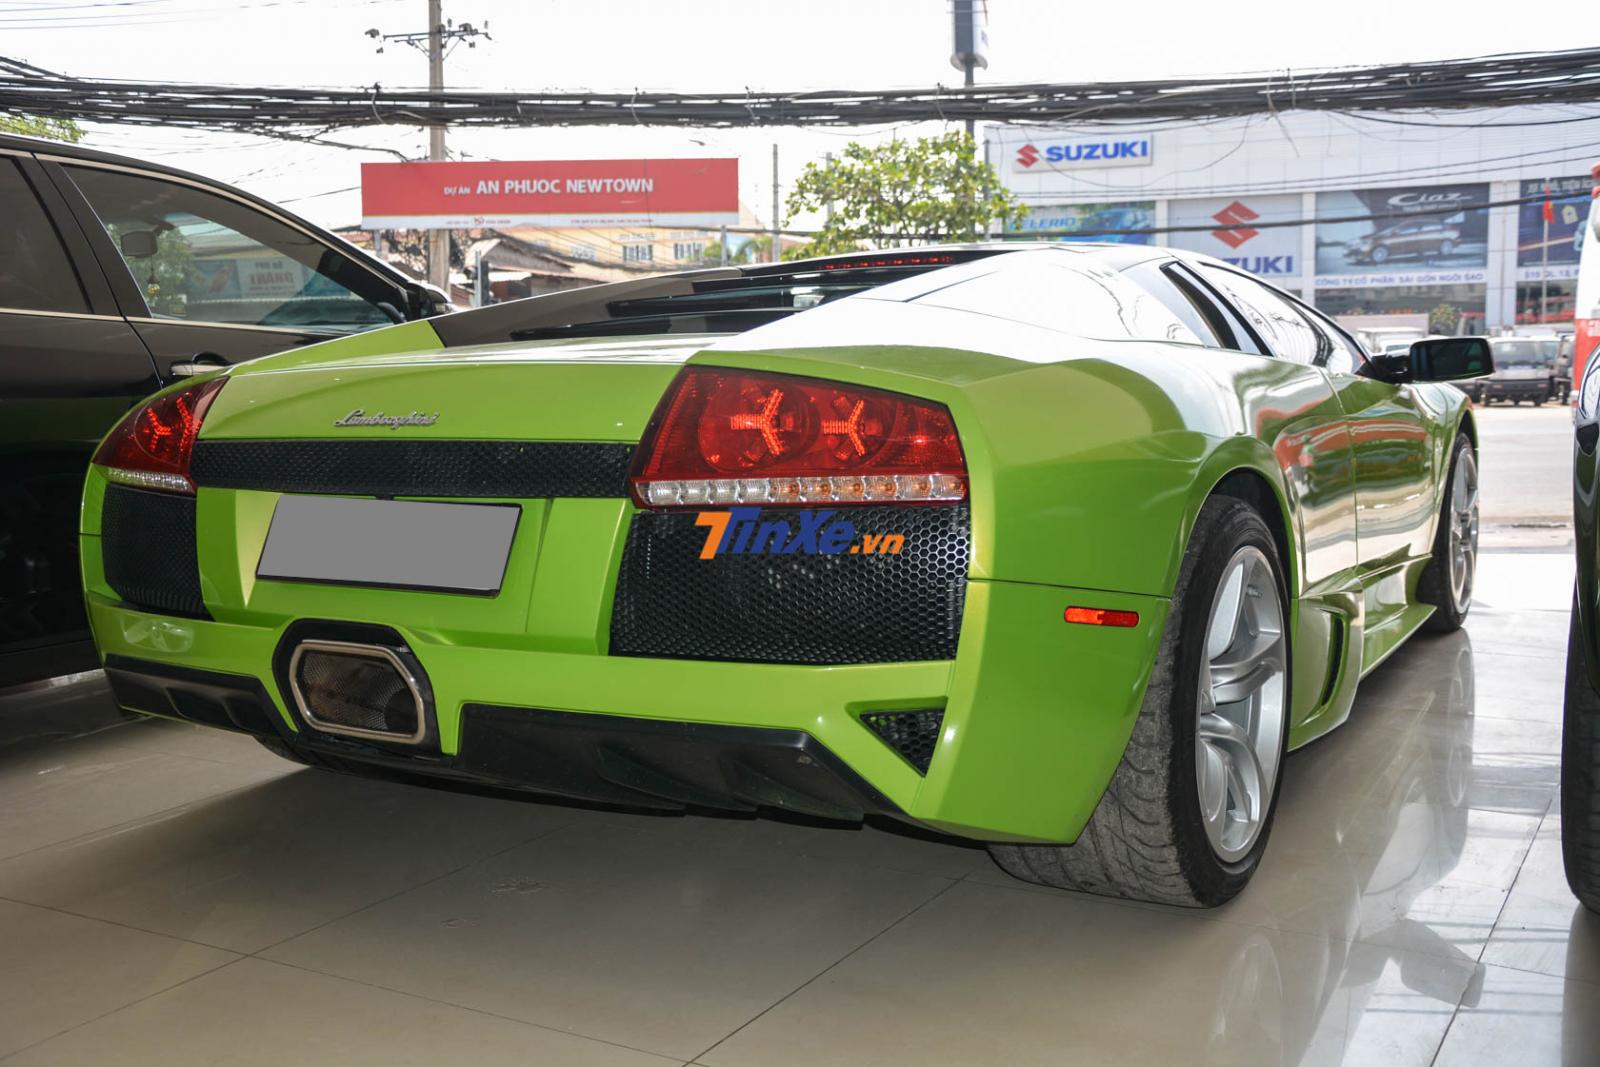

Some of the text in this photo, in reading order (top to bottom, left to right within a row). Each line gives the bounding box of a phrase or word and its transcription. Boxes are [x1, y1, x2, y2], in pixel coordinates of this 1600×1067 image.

[1046, 141, 1148, 162] SUZUKI
[476, 180, 500, 194] AN
[504, 179, 561, 193] PHUOC
[566, 178, 653, 193] NEWTOWN
[1387, 192, 1472, 206] Ciaz
[335, 408, 440, 430] Lamborghini
